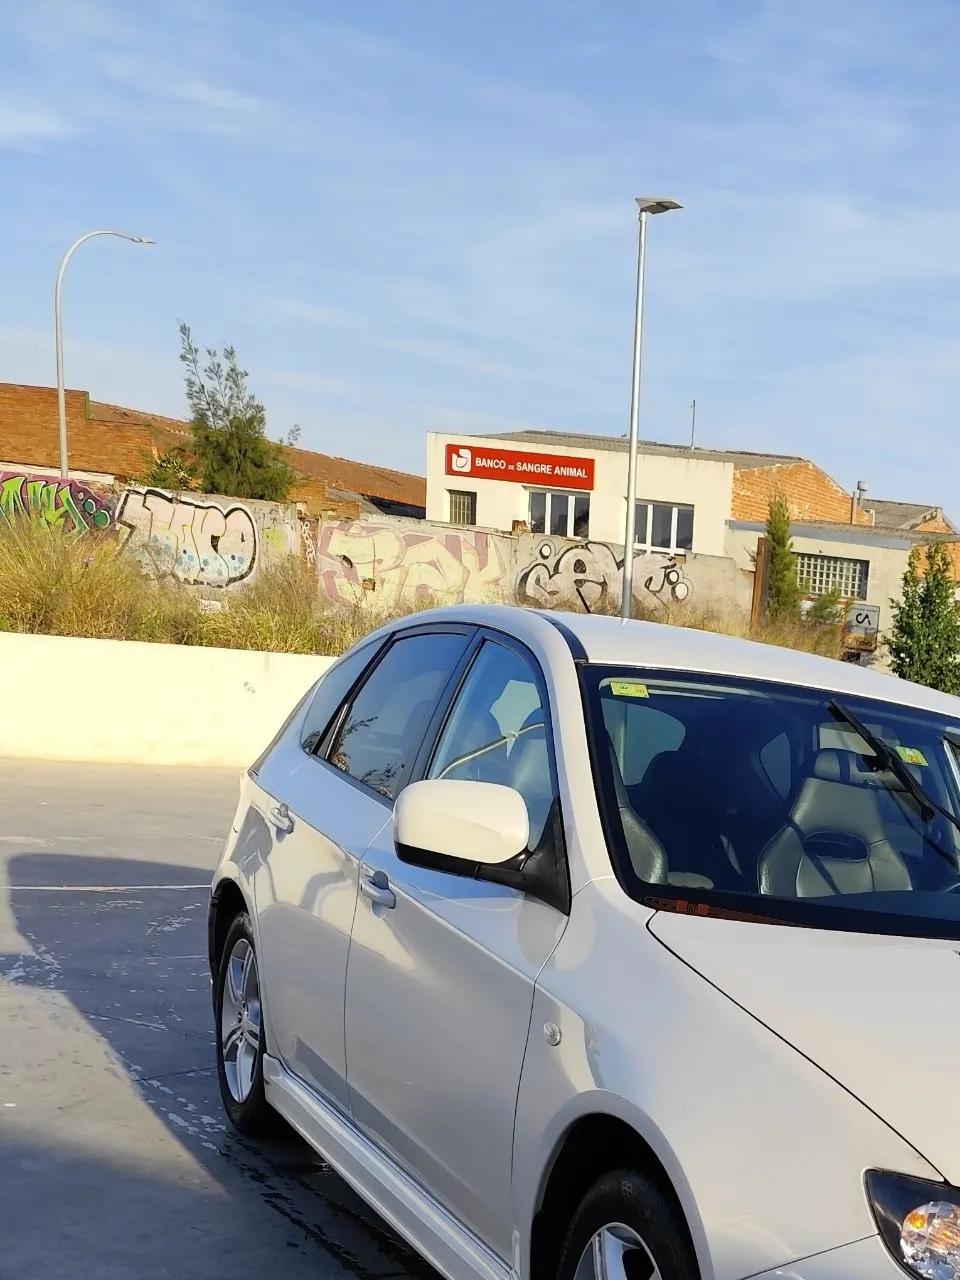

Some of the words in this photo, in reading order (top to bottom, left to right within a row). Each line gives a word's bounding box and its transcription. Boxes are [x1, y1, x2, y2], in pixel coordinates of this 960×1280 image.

[475, 457, 506, 469] BANCO
[516, 463, 552, 474] SANGRE
[554, 466, 587, 478] ANIMAL
